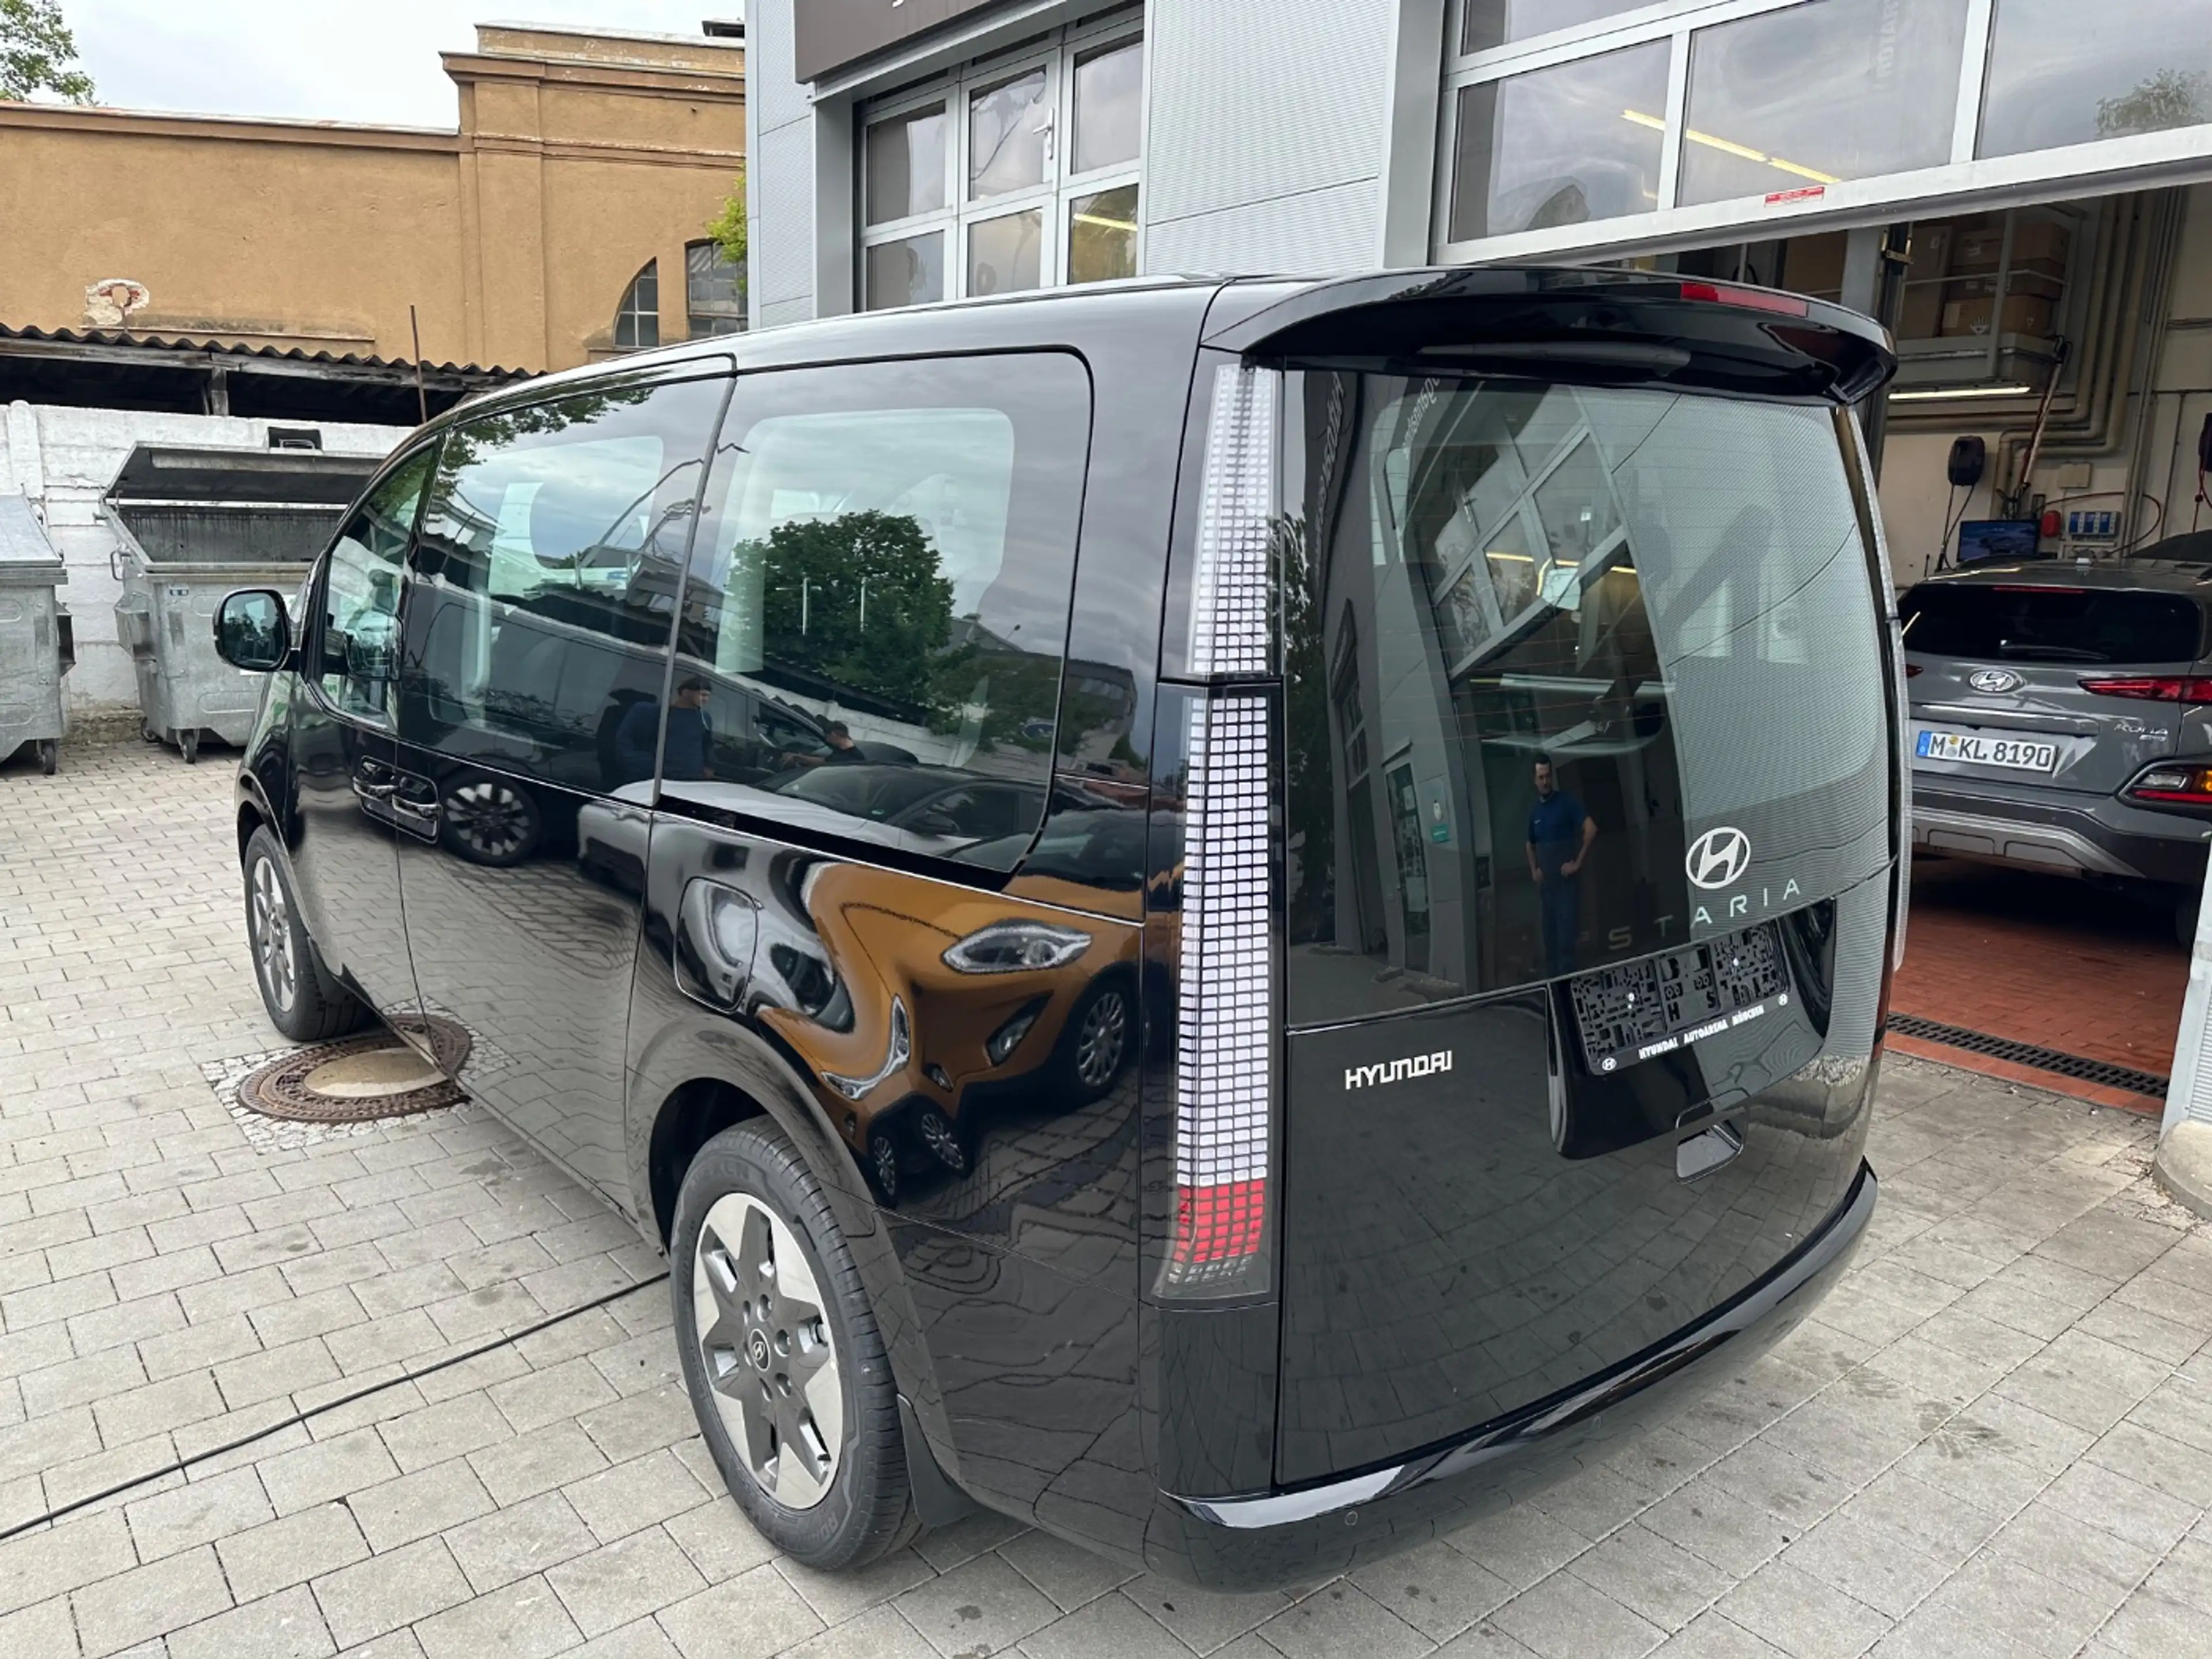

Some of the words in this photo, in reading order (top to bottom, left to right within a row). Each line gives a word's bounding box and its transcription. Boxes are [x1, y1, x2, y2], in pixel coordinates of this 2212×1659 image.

[1930, 735, 1946, 756] M
[1958, 738, 1987, 760] KL
[1993, 742, 2052, 768] 8190
[1608, 878, 1801, 950] STARIA
[1638, 1037, 1679, 1059] HYUNDAI
[1683, 1018, 1729, 1044] AUTOARENA
[1344, 1050, 1452, 1090] HYUNDAI
